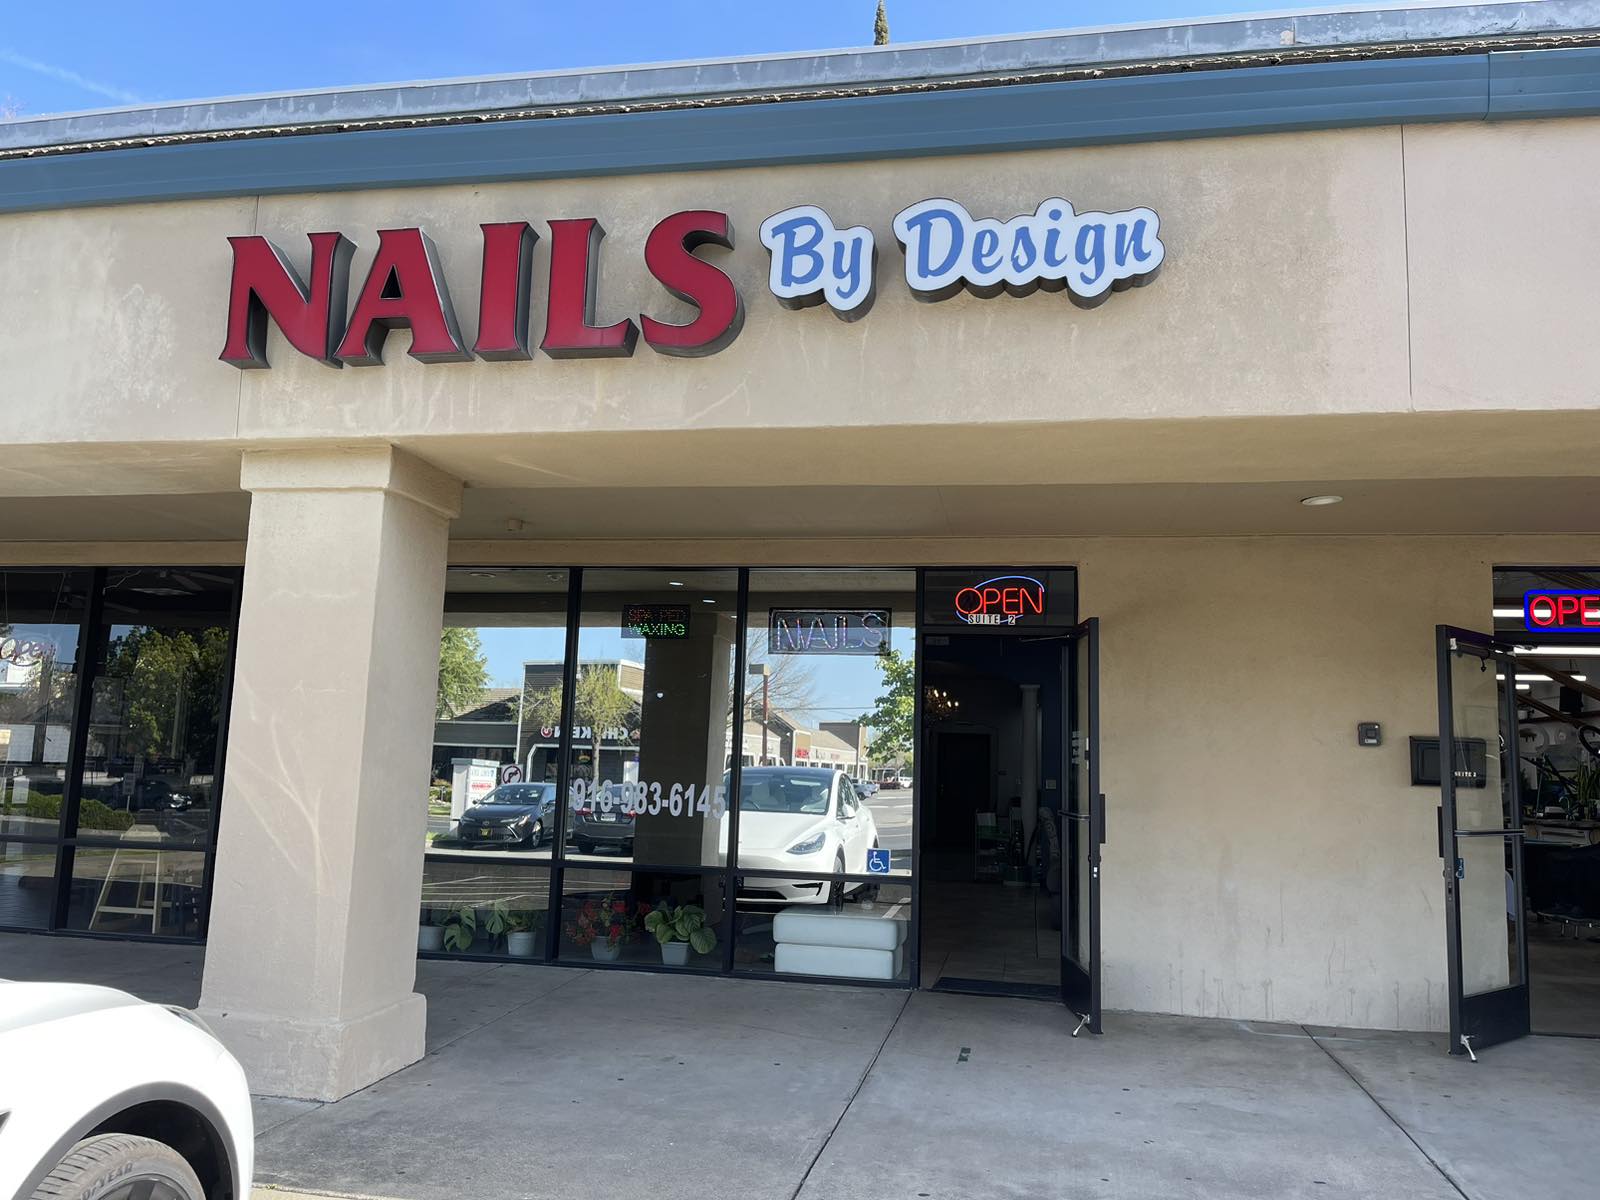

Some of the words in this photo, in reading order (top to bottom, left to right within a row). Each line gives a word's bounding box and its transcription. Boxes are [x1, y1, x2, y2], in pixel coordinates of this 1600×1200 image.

[219, 210, 742, 365] NAILS
[771, 215, 862, 300] By
[905, 208, 1152, 286] Design
[955, 587, 1043, 614] OPEN
[1529, 595, 1600, 626] OPE
[628, 623, 686, 635] WAXING
[777, 613, 887, 649] NAILS
[968, 614, 1000, 625] SUITE
[1008, 614, 1016, 626] 2
[572, 778, 727, 819] 916-983-6145
